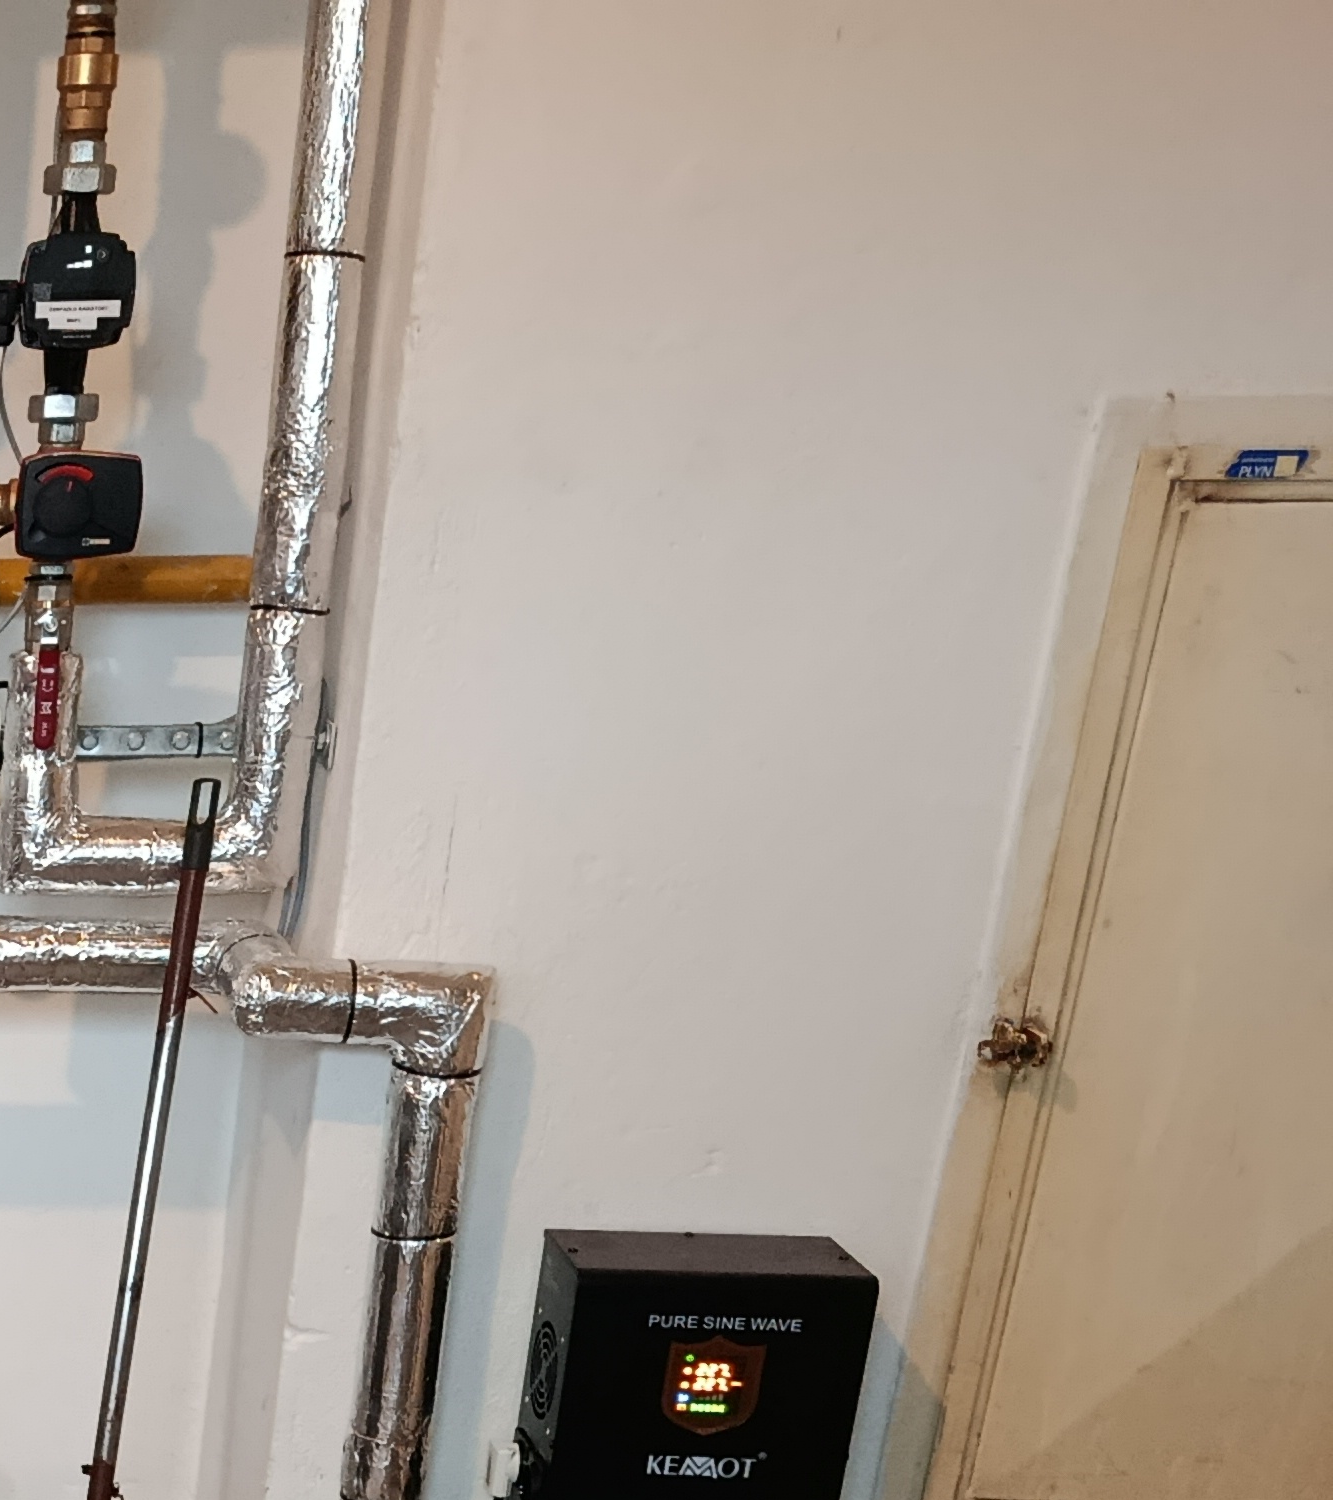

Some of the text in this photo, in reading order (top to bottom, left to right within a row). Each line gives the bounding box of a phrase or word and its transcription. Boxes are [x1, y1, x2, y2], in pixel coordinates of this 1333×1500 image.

[1238, 466, 1273, 478] PLYN
[648, 1315, 803, 1332] PURE SINE WAVE
